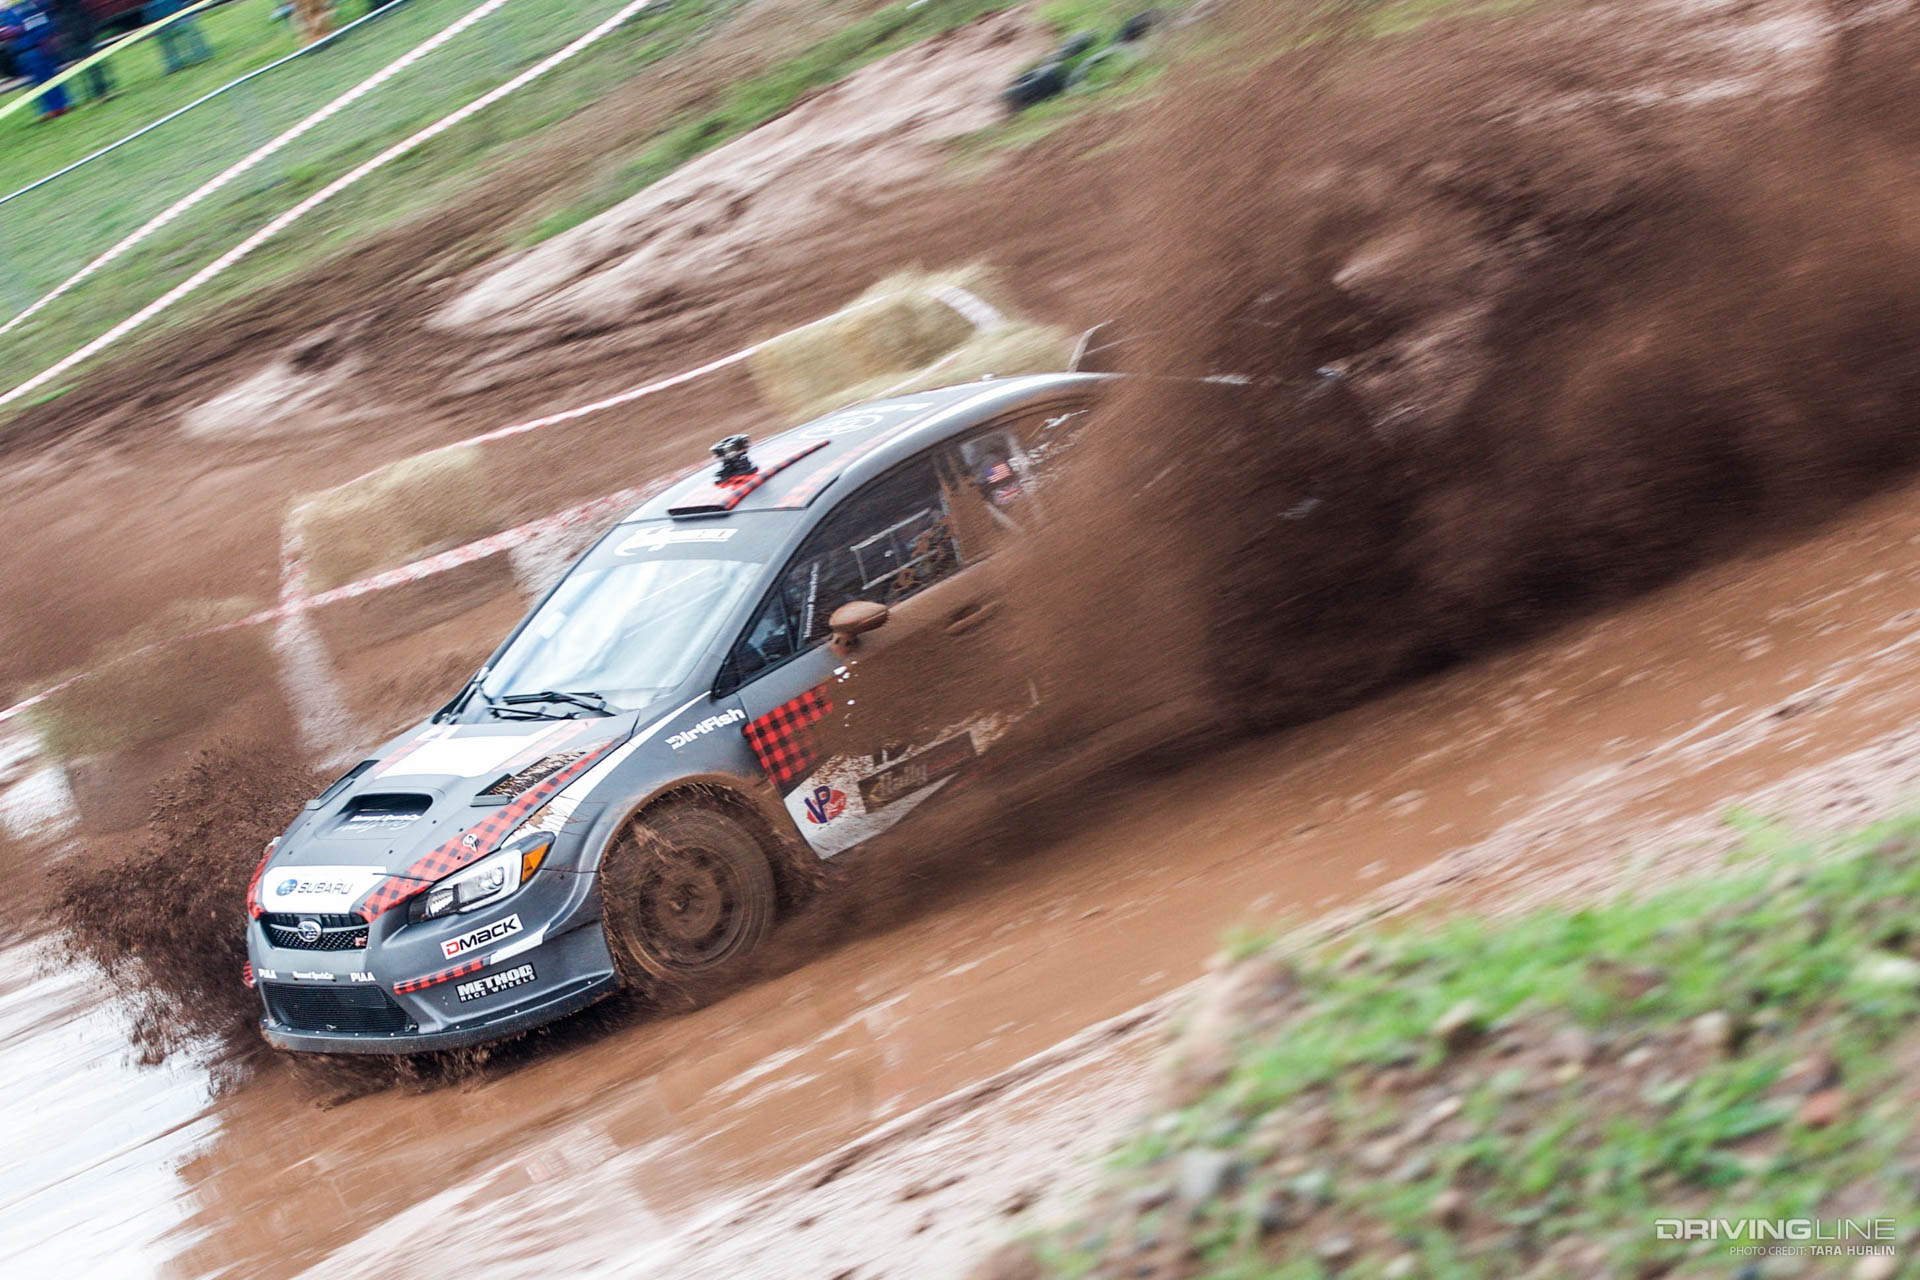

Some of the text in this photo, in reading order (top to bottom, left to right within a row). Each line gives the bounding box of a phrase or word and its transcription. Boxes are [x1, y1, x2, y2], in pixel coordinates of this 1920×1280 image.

[804, 786, 831, 824] VP
[298, 881, 353, 895] SUBARU
[258, 968, 277, 979] PIAA
[350, 971, 376, 982] PIAA
[457, 964, 534, 997] METHOD
[460, 974, 536, 1002] RACE WHEELS
